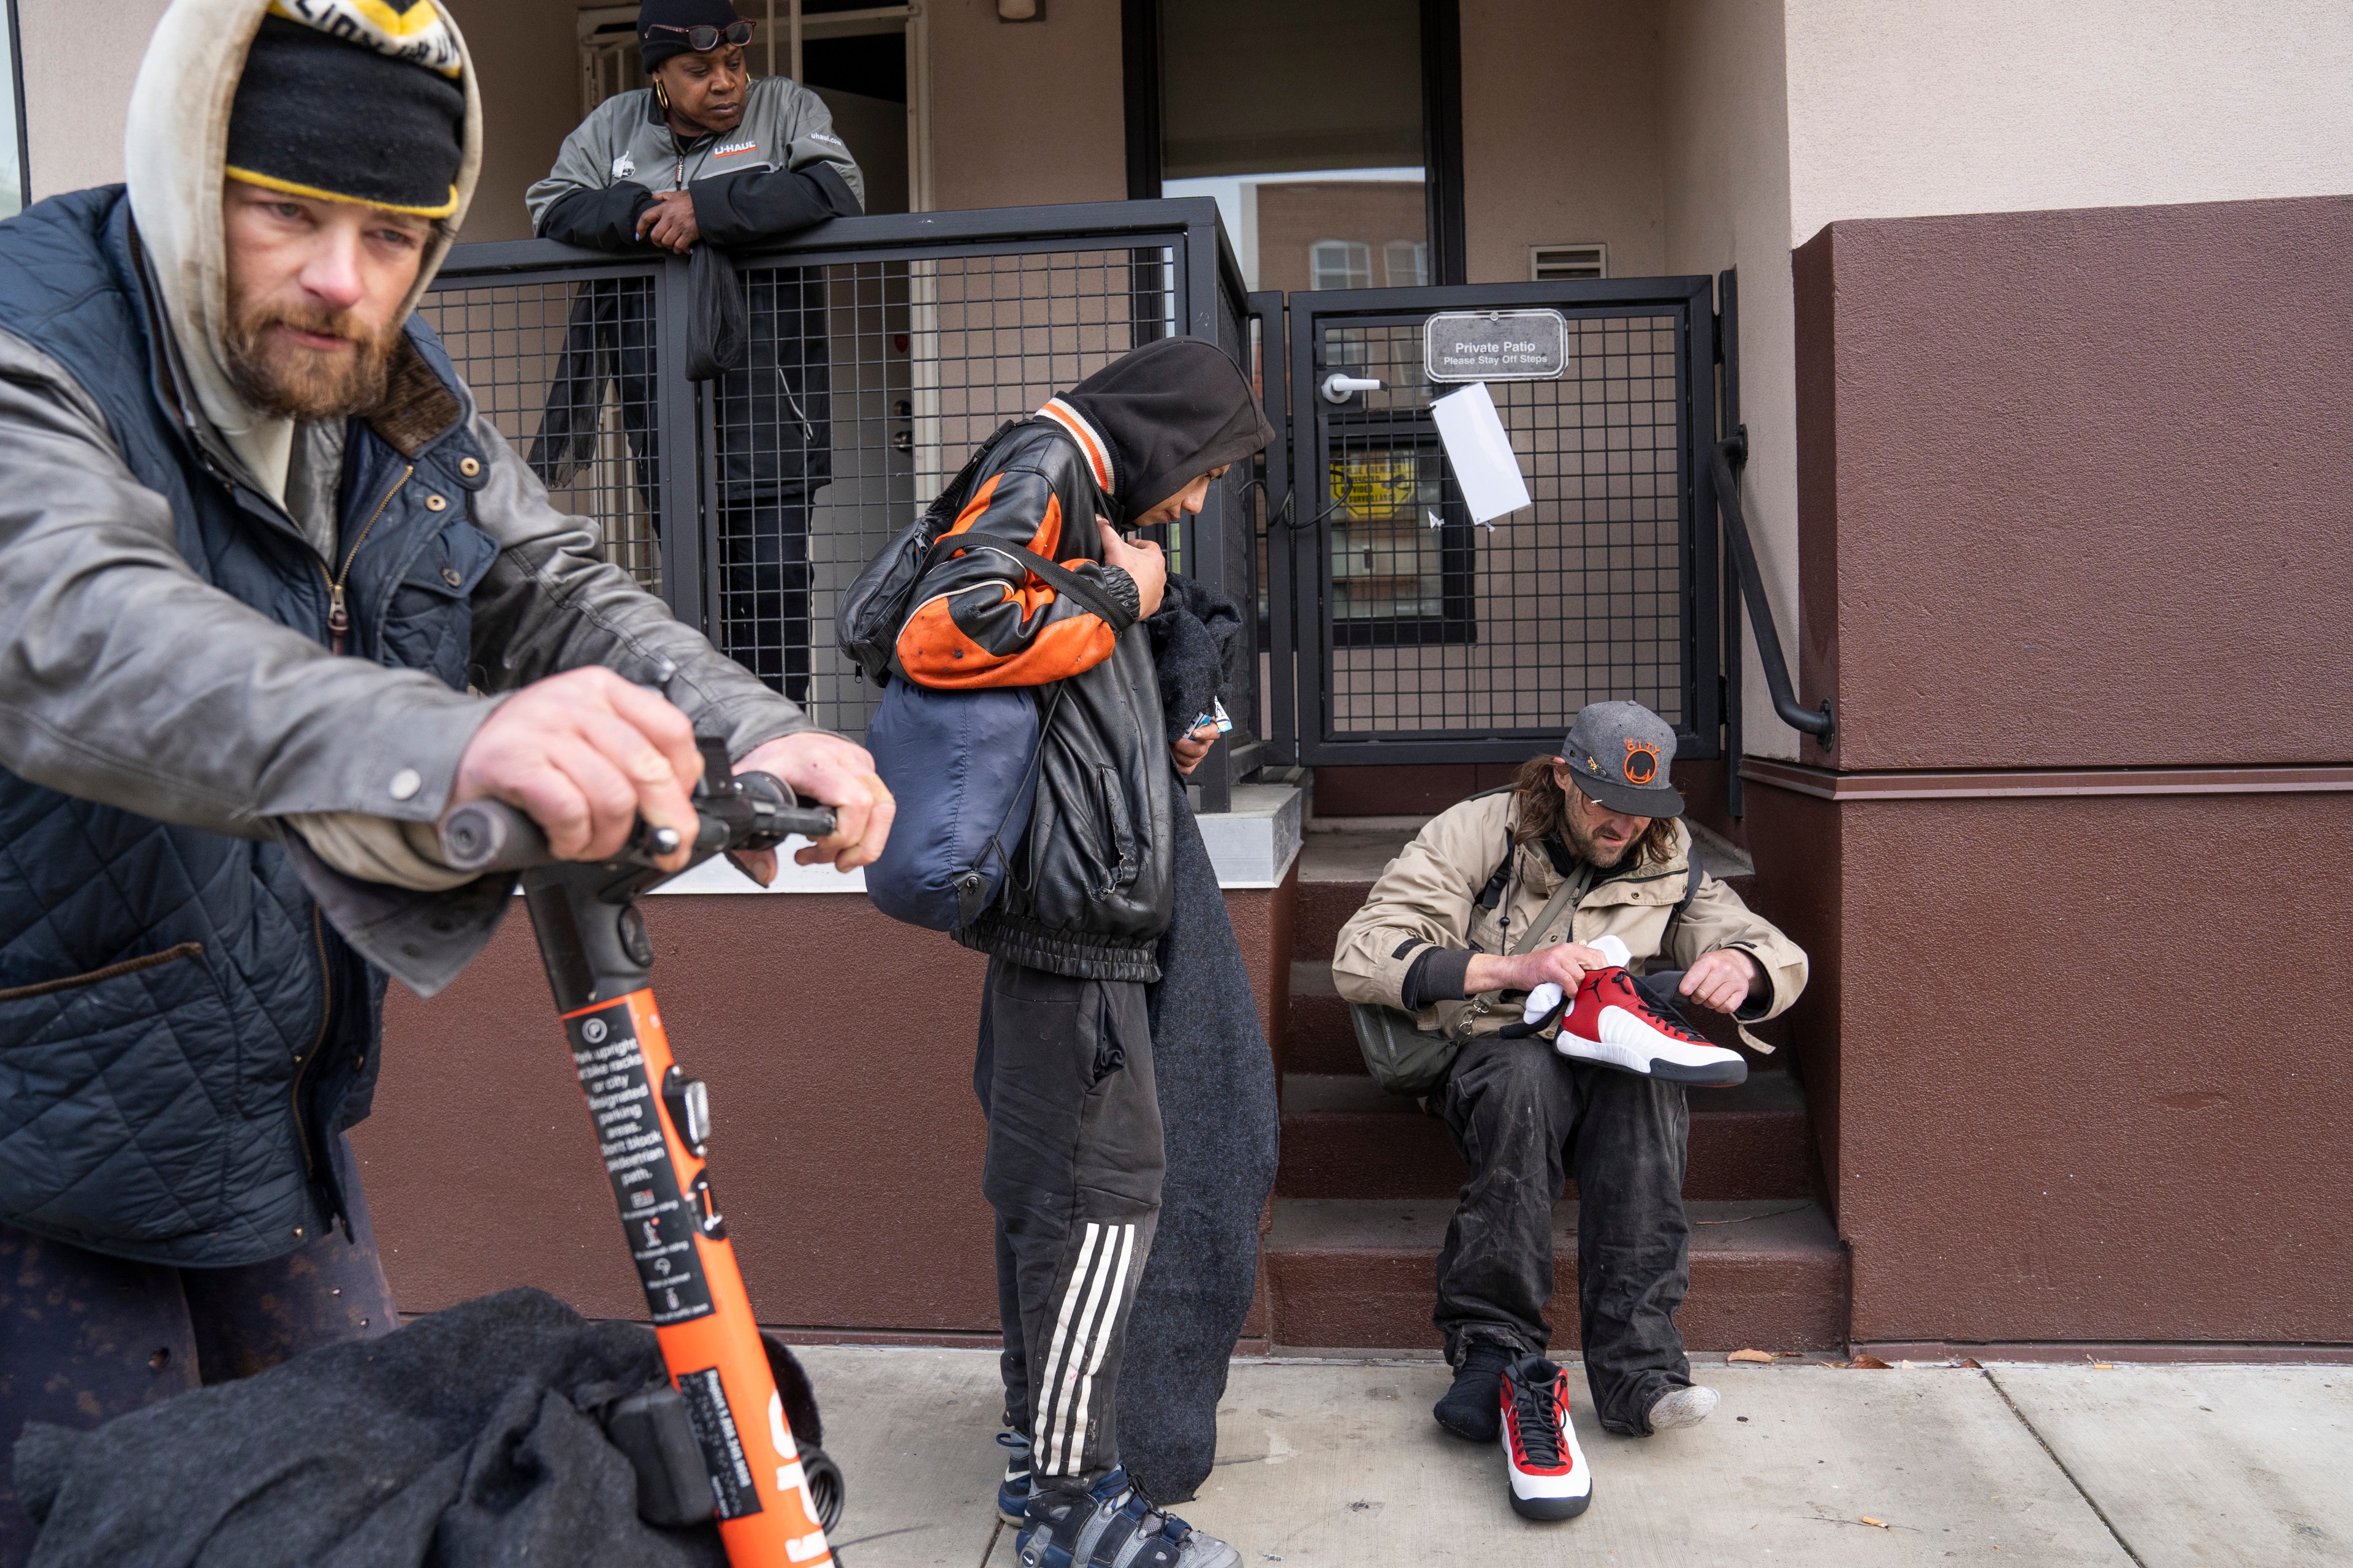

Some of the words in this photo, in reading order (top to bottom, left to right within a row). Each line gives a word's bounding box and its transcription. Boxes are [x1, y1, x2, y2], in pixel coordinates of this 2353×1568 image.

[811, 132, 842, 147] uhaul.com
[714, 140, 756, 155] U-HAUL
[1456, 342, 1500, 354] Private
[1503, 341, 1536, 352] Patio
[1444, 357, 1475, 365] Please
[1478, 356, 1500, 366] Stay
[1520, 355, 1548, 365] Steps
[1626, 741, 1661, 755] CITY
[593, 1038, 639, 1061] upright
[605, 1074, 629, 1091] city
[598, 1104, 643, 1127] parking
